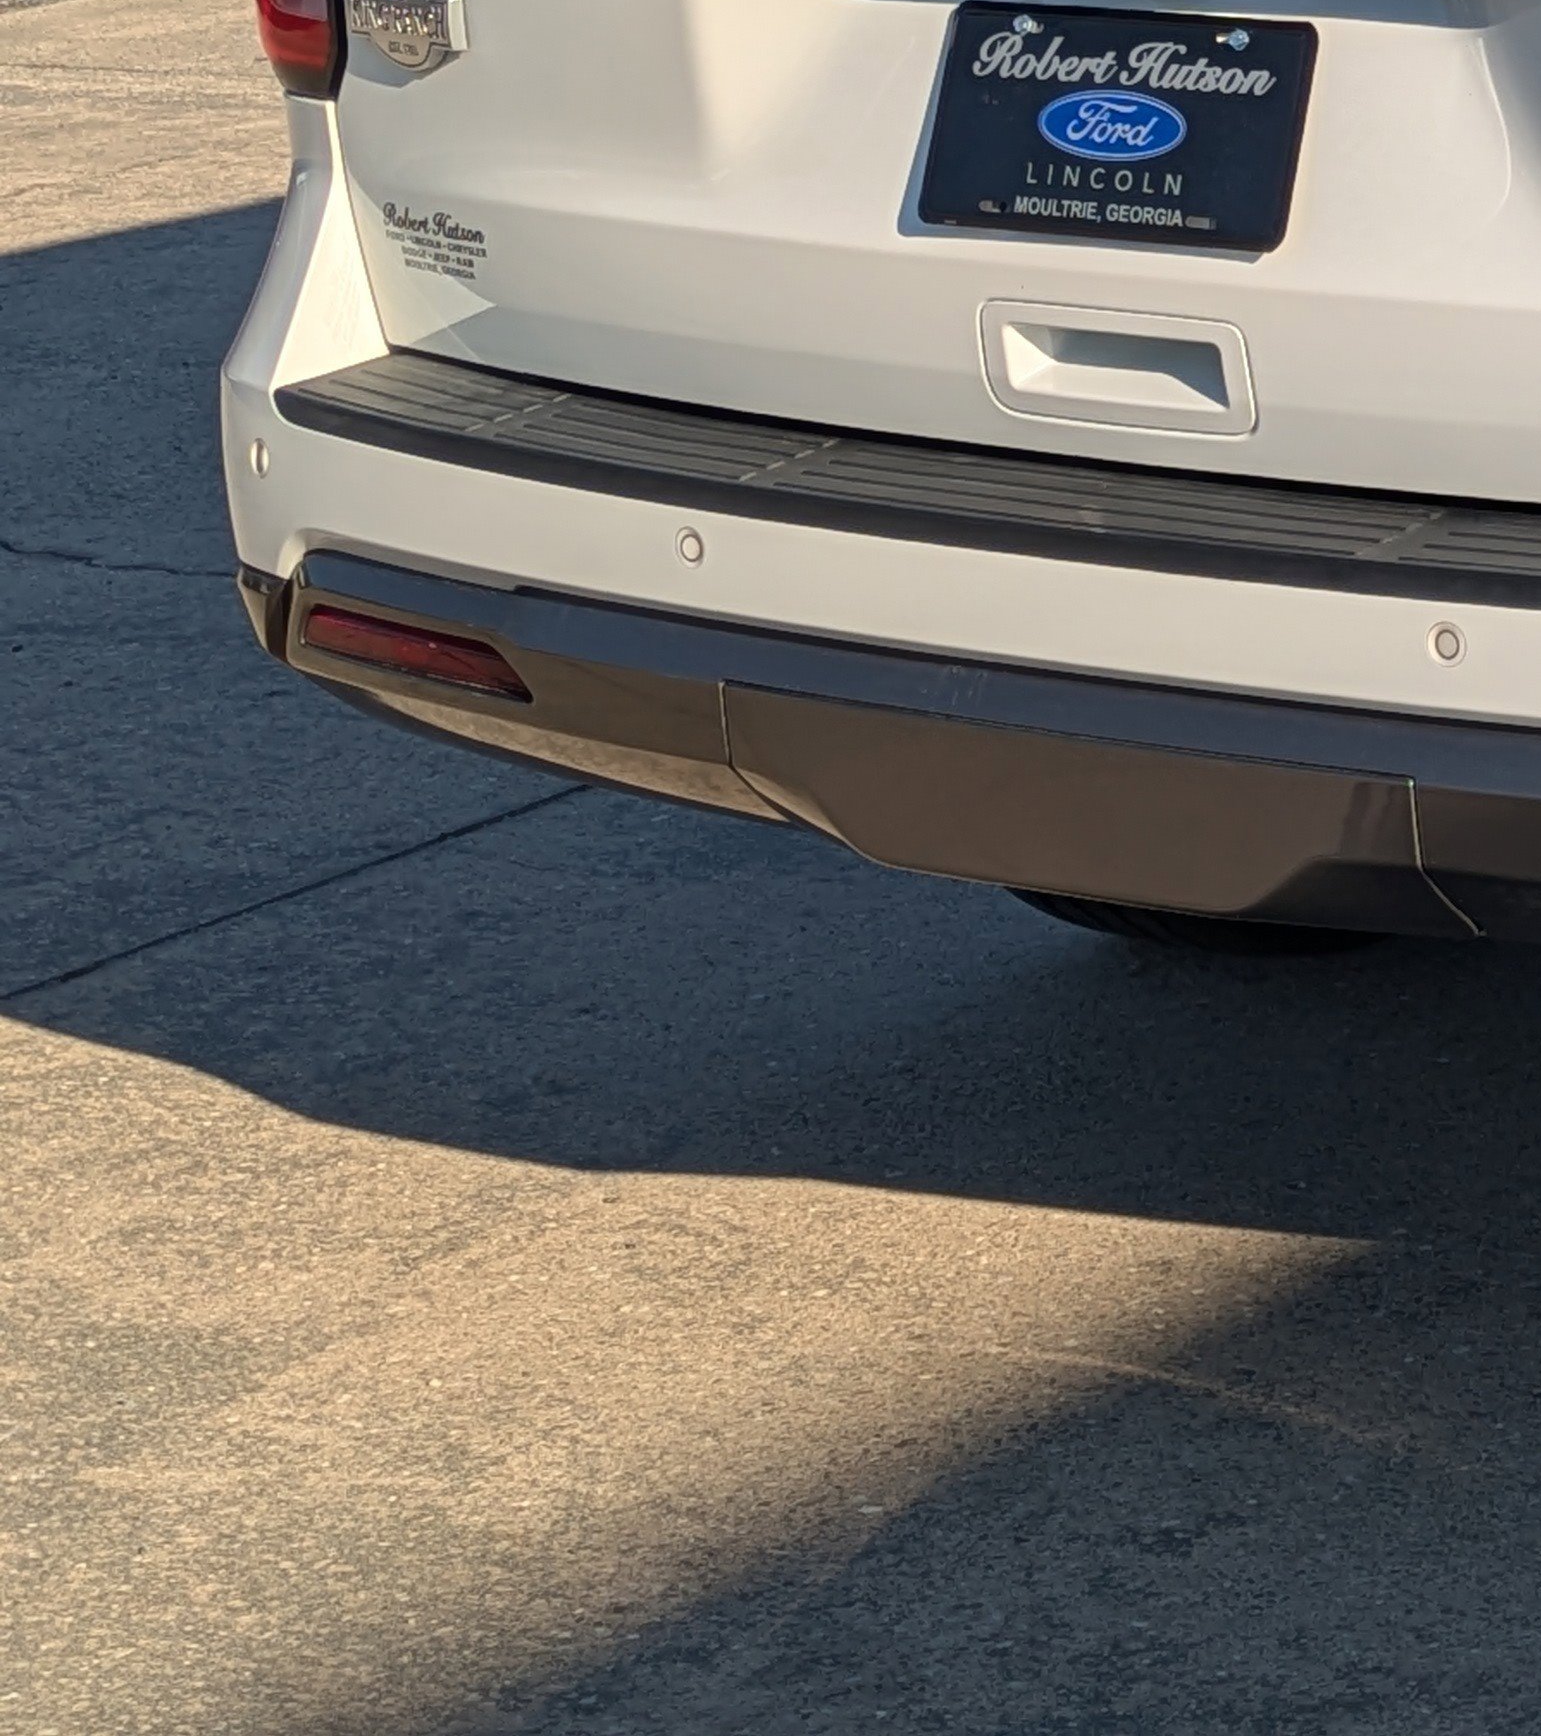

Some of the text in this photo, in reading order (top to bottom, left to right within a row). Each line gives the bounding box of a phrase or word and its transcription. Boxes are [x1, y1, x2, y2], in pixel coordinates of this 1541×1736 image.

[972, 31, 1278, 96] Robert Hutson
[1066, 100, 1159, 146] Ford
[1026, 161, 1183, 196] LINCOLN
[383, 202, 486, 244] Robert Hutson
[1013, 195, 1184, 227] MOULTRIE, GEORGIA
